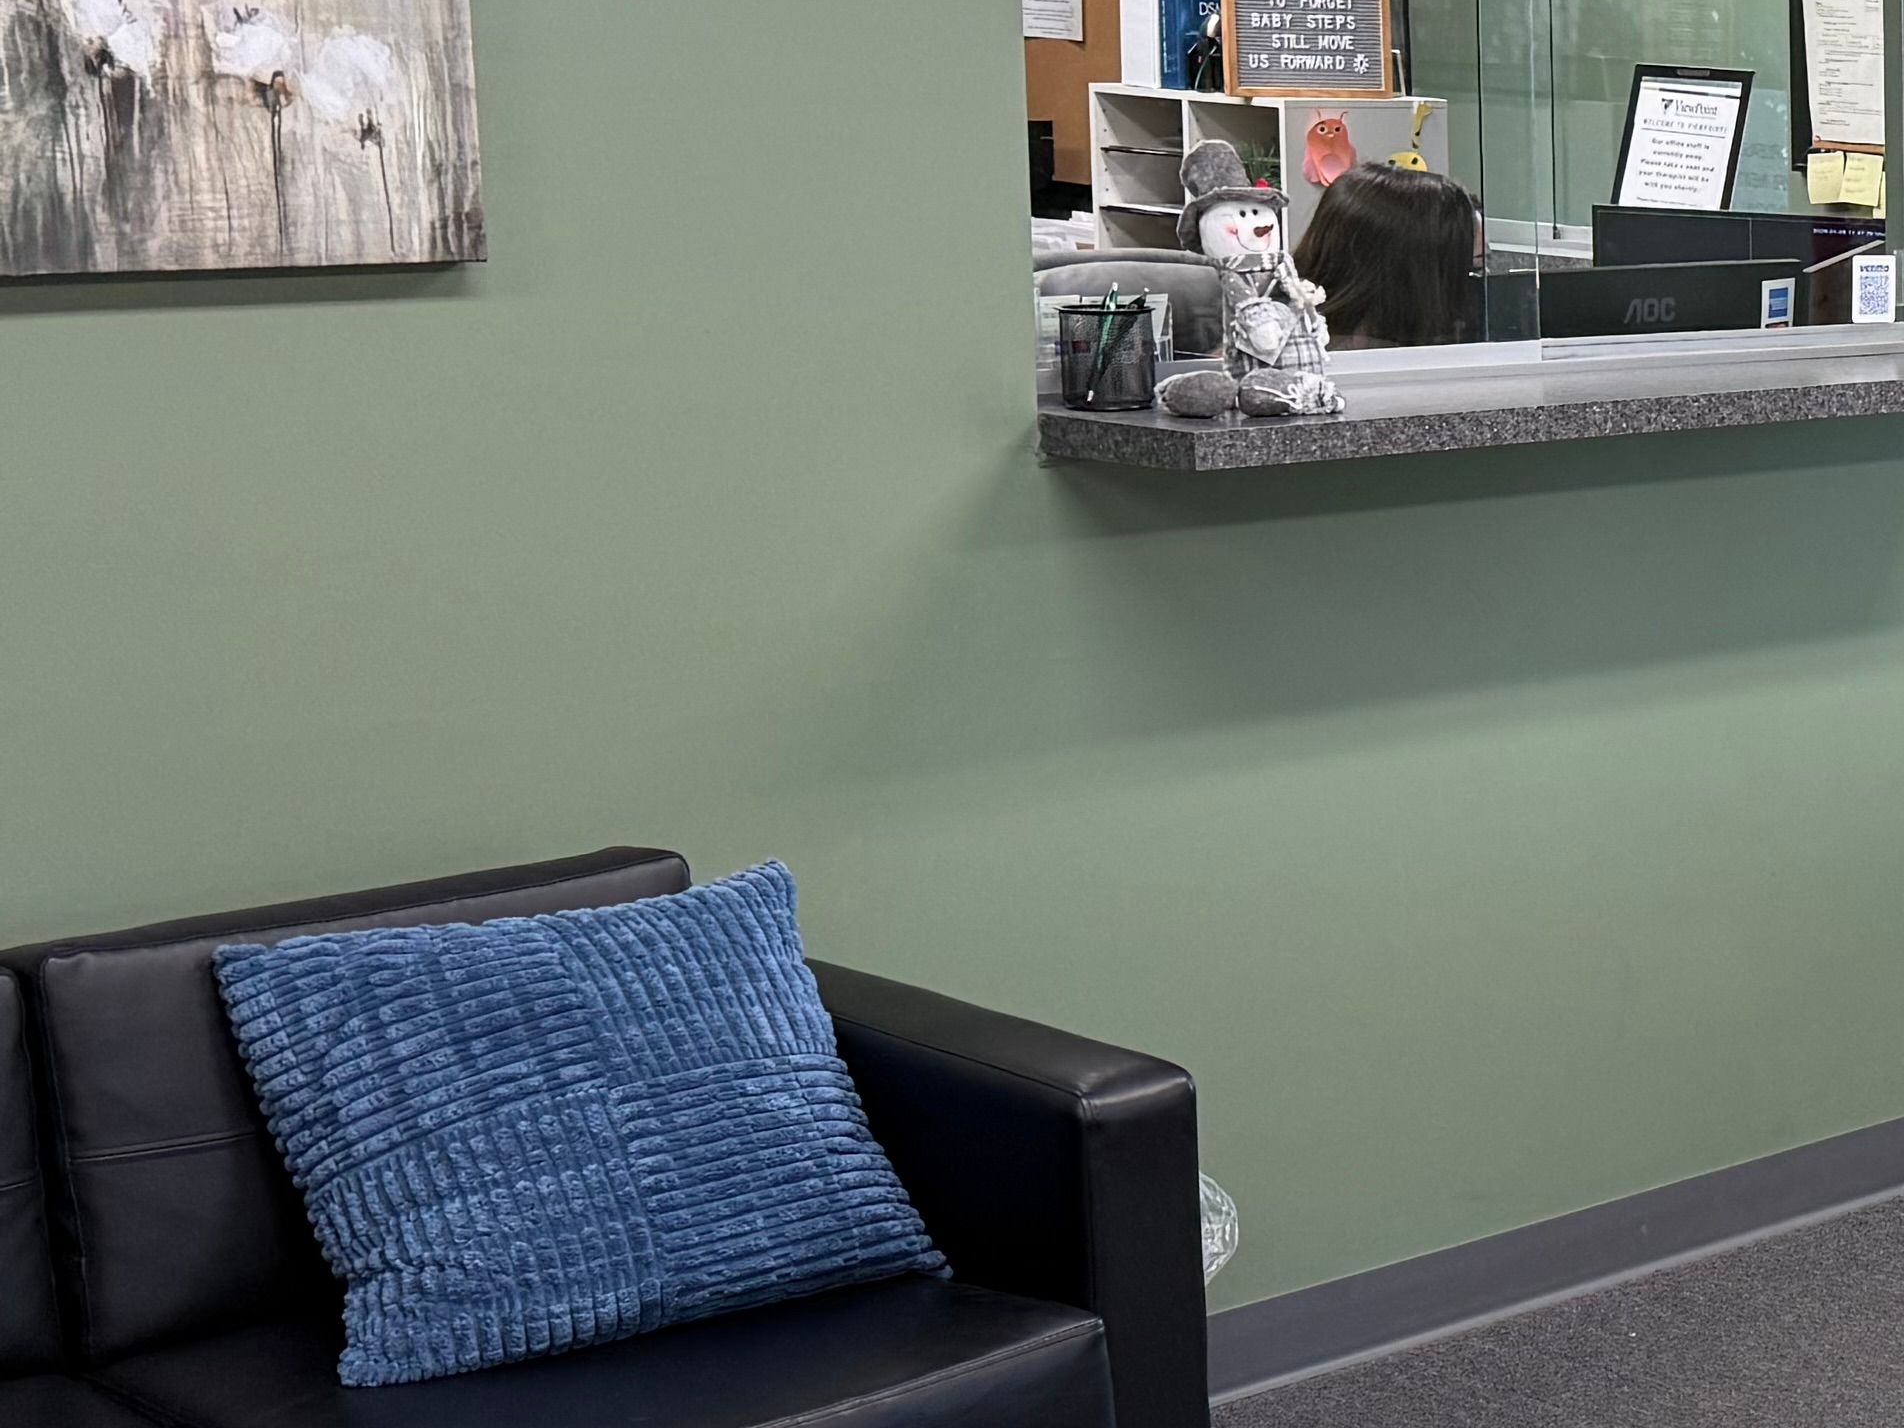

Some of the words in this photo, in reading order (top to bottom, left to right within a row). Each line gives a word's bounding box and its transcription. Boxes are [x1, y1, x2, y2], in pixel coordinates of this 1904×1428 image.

[1251, 12, 1293, 30] BABY
[1306, 14, 1356, 30] STEPS
[1271, 33, 1310, 50] STILL
[1318, 35, 1354, 51] MOVE
[1249, 54, 1269, 69] US
[1280, 54, 1346, 71] FORWARD
[1623, 296, 1677, 324] AOC
